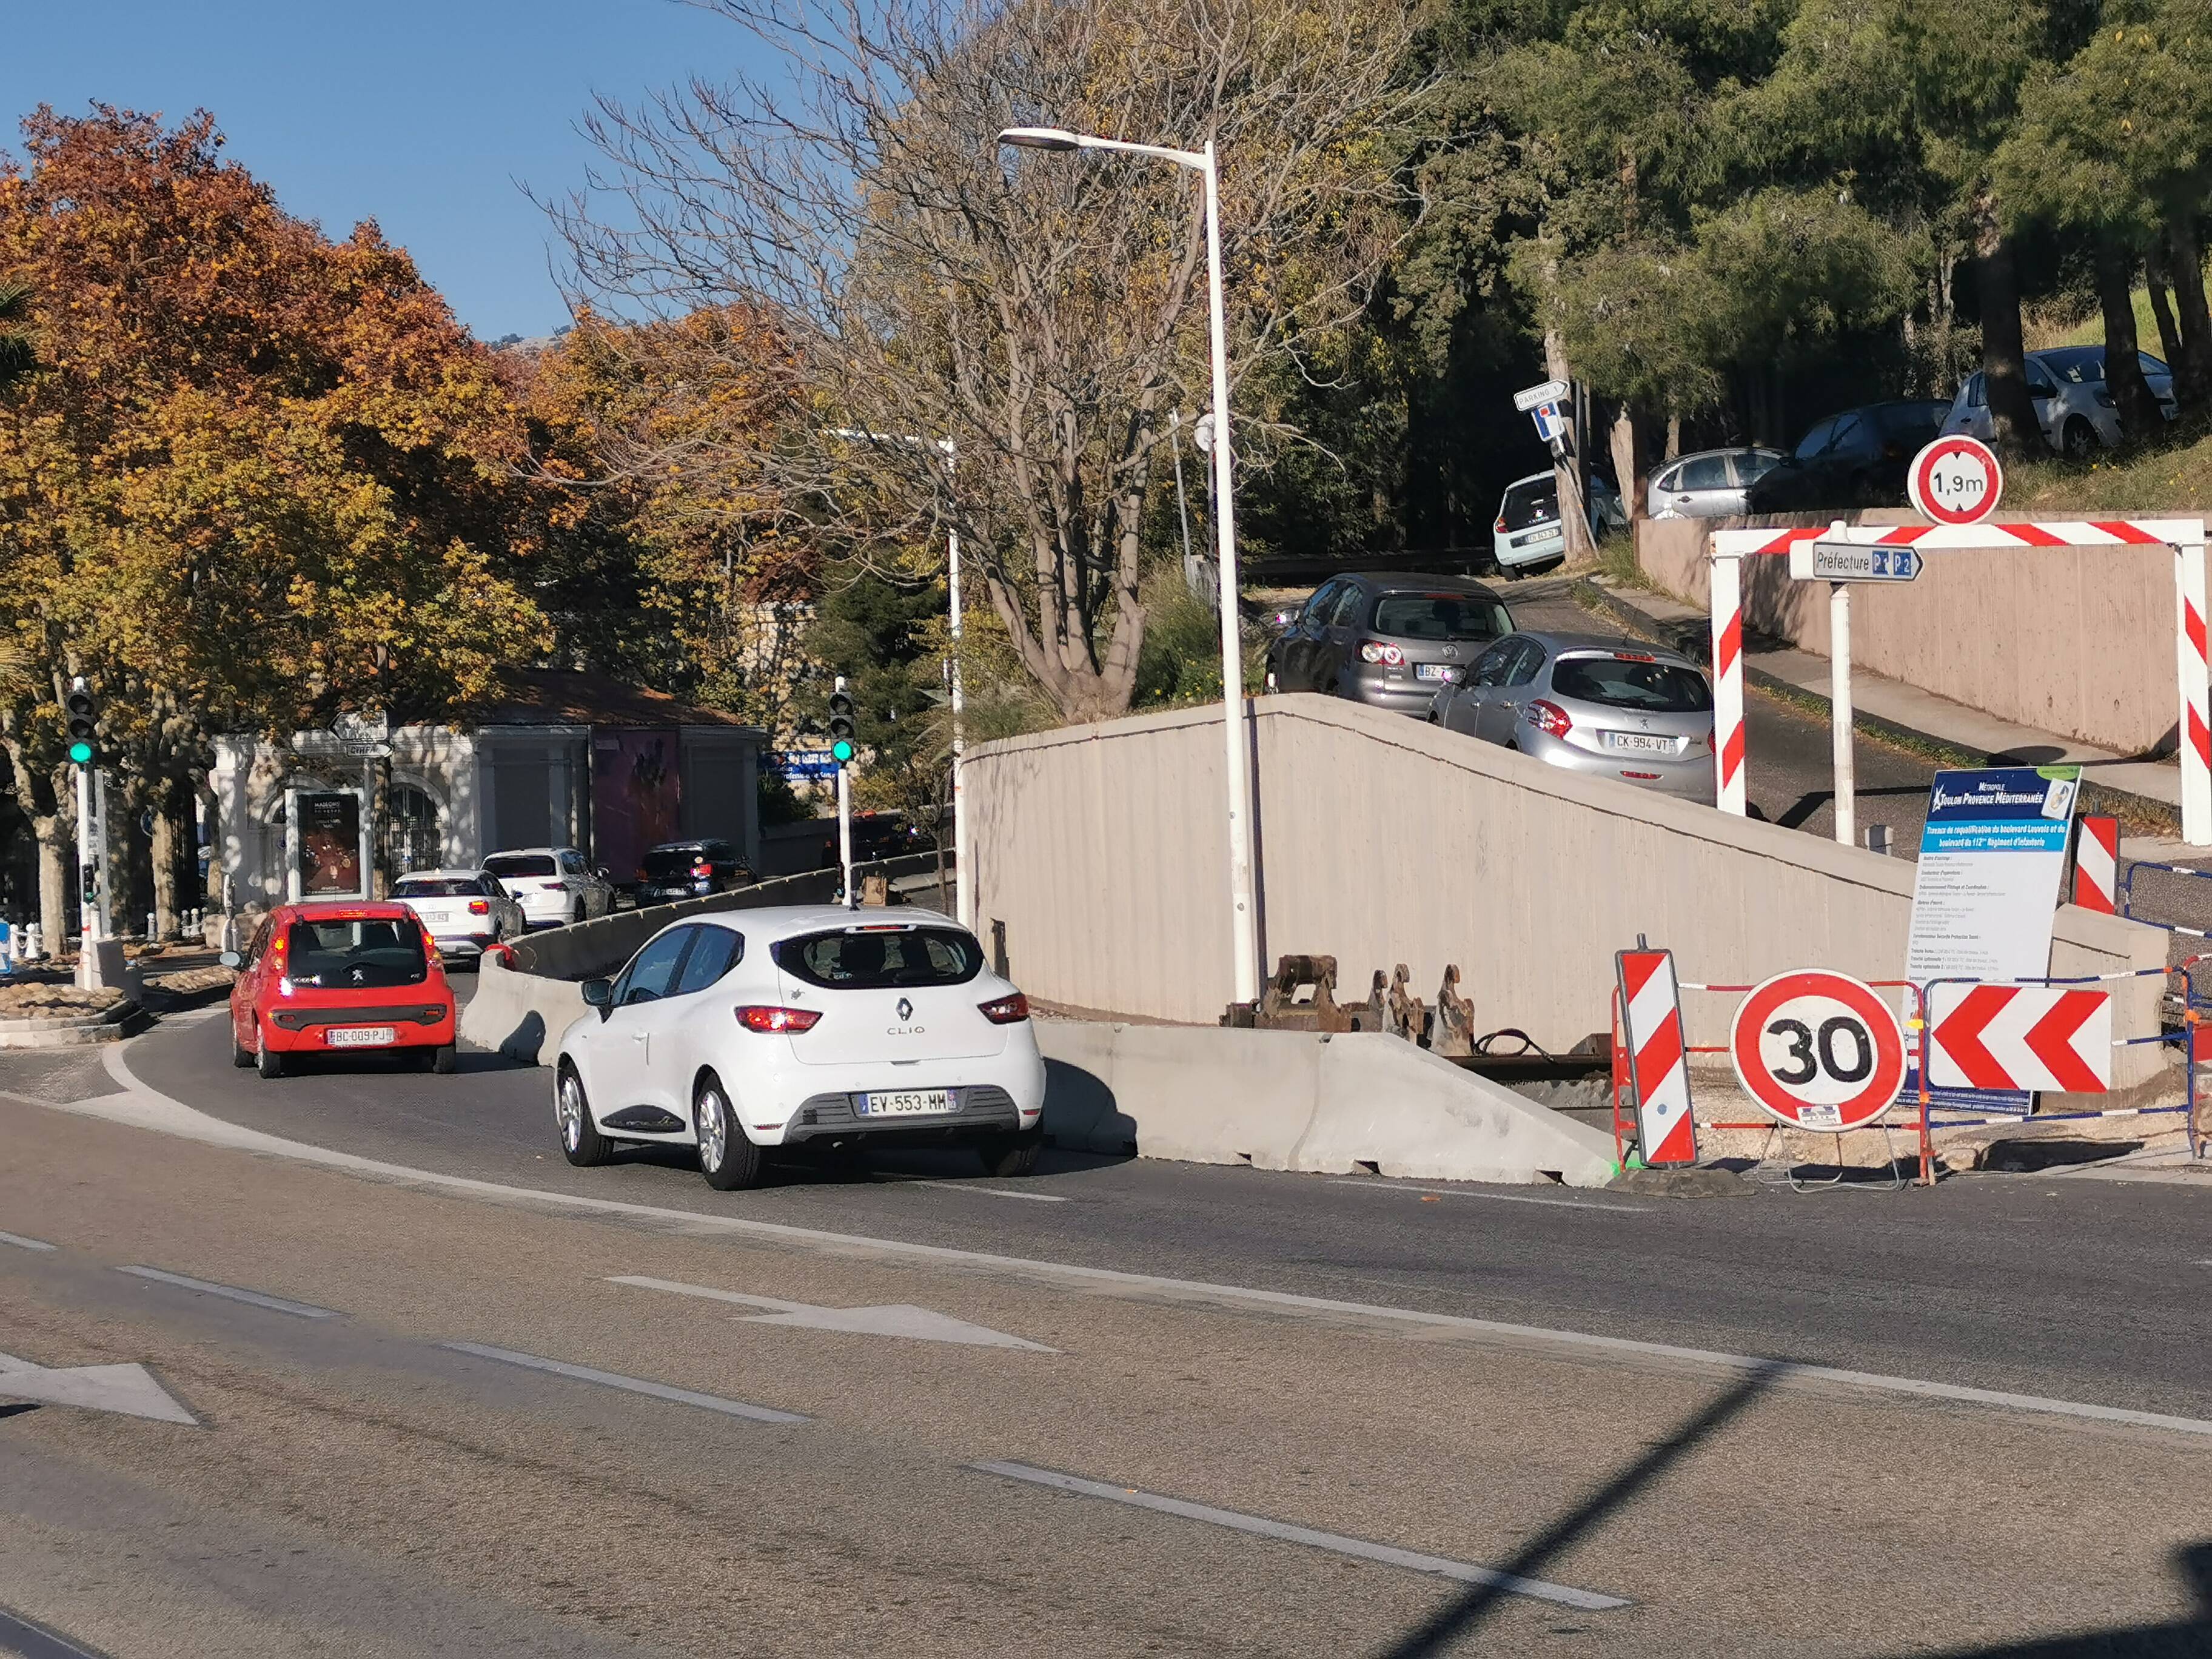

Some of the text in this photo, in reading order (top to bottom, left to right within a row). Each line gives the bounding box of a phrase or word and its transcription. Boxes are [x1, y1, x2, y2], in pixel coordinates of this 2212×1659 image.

[1518, 389, 1550, 404] PARKING
[1933, 472, 1983, 495] 1,9m
[1817, 552, 1869, 571] Préfecture
[1617, 735, 1667, 750] CK-994-VT
[336, 1031, 385, 1042] BC-009-PJ
[887, 1026, 925, 1035] CLIO
[1766, 1016, 1872, 1085] 30
[870, 1093, 946, 1112] EV-553-MM
